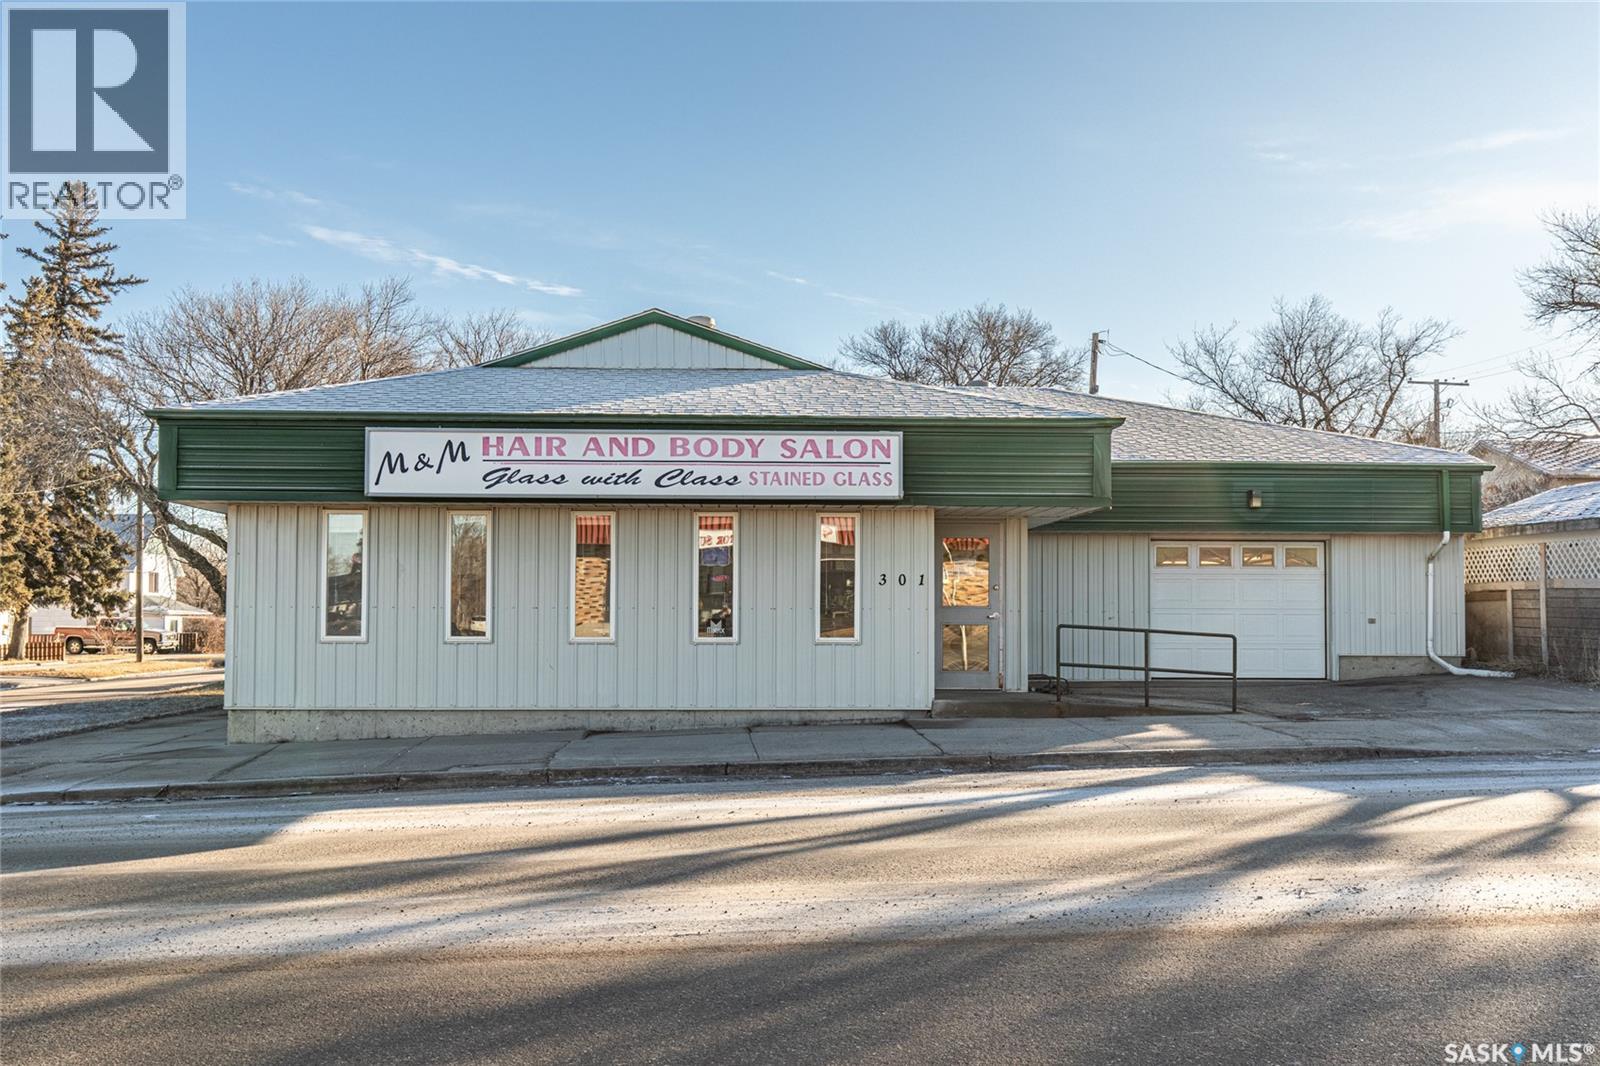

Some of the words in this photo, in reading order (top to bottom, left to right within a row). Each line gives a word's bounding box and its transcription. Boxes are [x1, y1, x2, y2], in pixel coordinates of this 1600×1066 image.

[481, 436, 567, 457] HAIR
[582, 436, 656, 458] AND
[669, 437, 765, 458] BODY
[780, 438, 891, 459] SALON
[482, 467, 569, 489] Glass
[581, 468, 642, 486] with
[654, 468, 742, 488] Class
[748, 471, 826, 487] STAINED
[832, 471, 893, 487] GLASS
